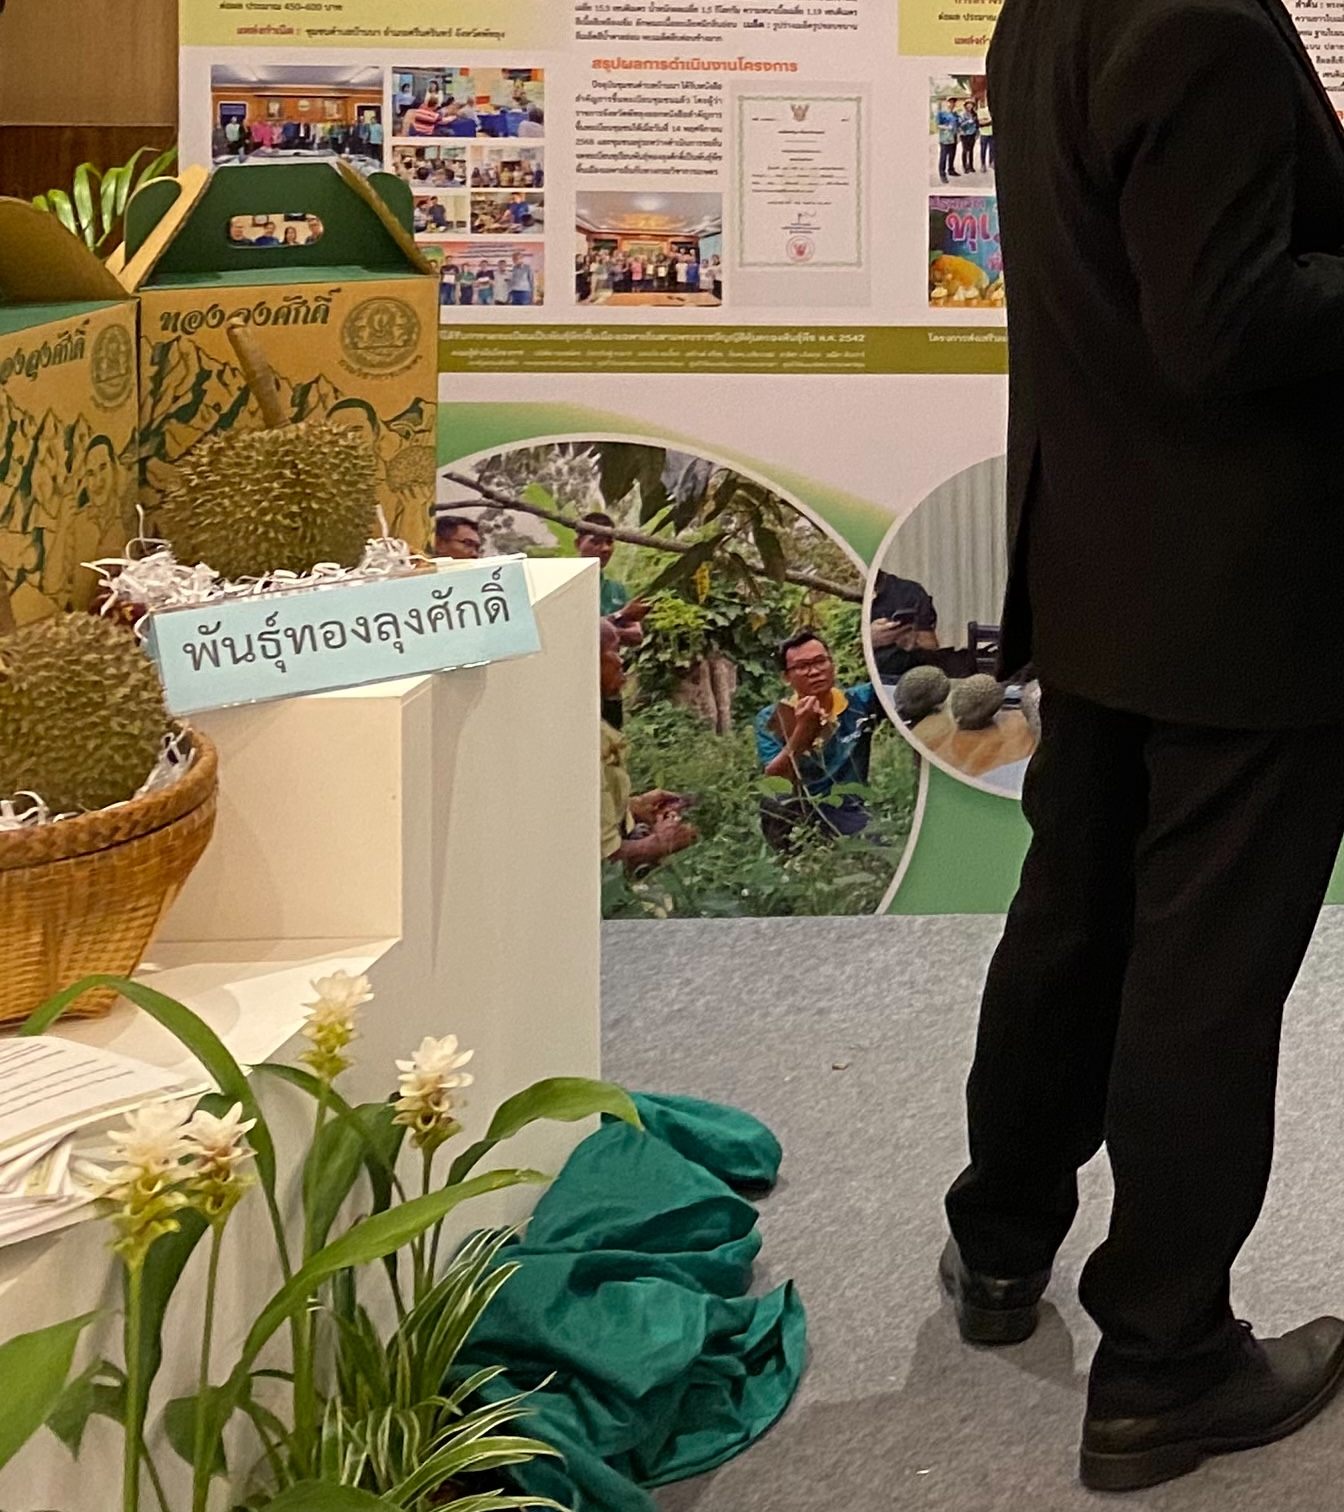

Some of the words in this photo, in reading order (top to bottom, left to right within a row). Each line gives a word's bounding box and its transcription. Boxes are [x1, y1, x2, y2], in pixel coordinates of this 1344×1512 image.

[591, 57, 798, 74] สรุปผลการดำเนินงานโครงการ
[181, 567, 511, 674] พันธุ์ทองลุงศักดิ์
